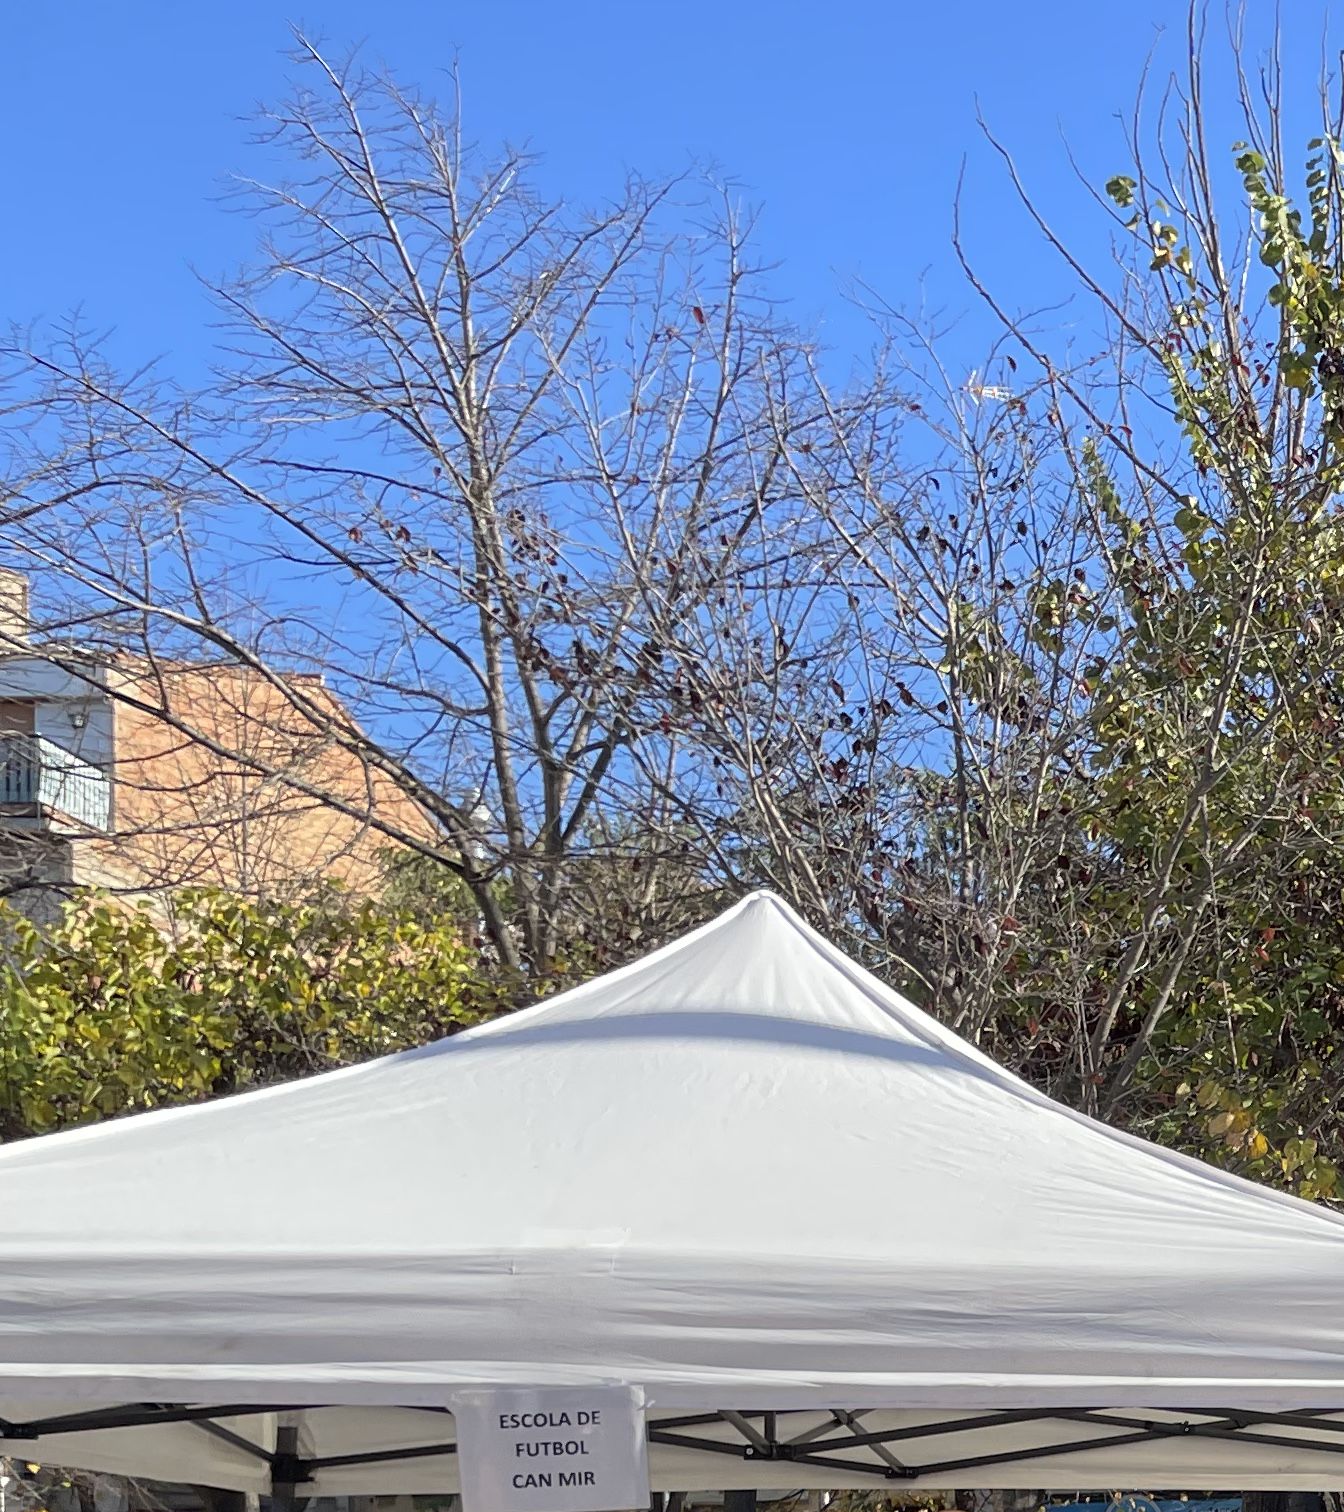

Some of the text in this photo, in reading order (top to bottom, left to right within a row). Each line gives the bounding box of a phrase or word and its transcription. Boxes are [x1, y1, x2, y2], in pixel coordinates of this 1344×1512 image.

[499, 1410, 601, 1429] ESCOLA DE
[515, 1440, 589, 1457] FUTBOL
[512, 1471, 596, 1489] CAN MIR
